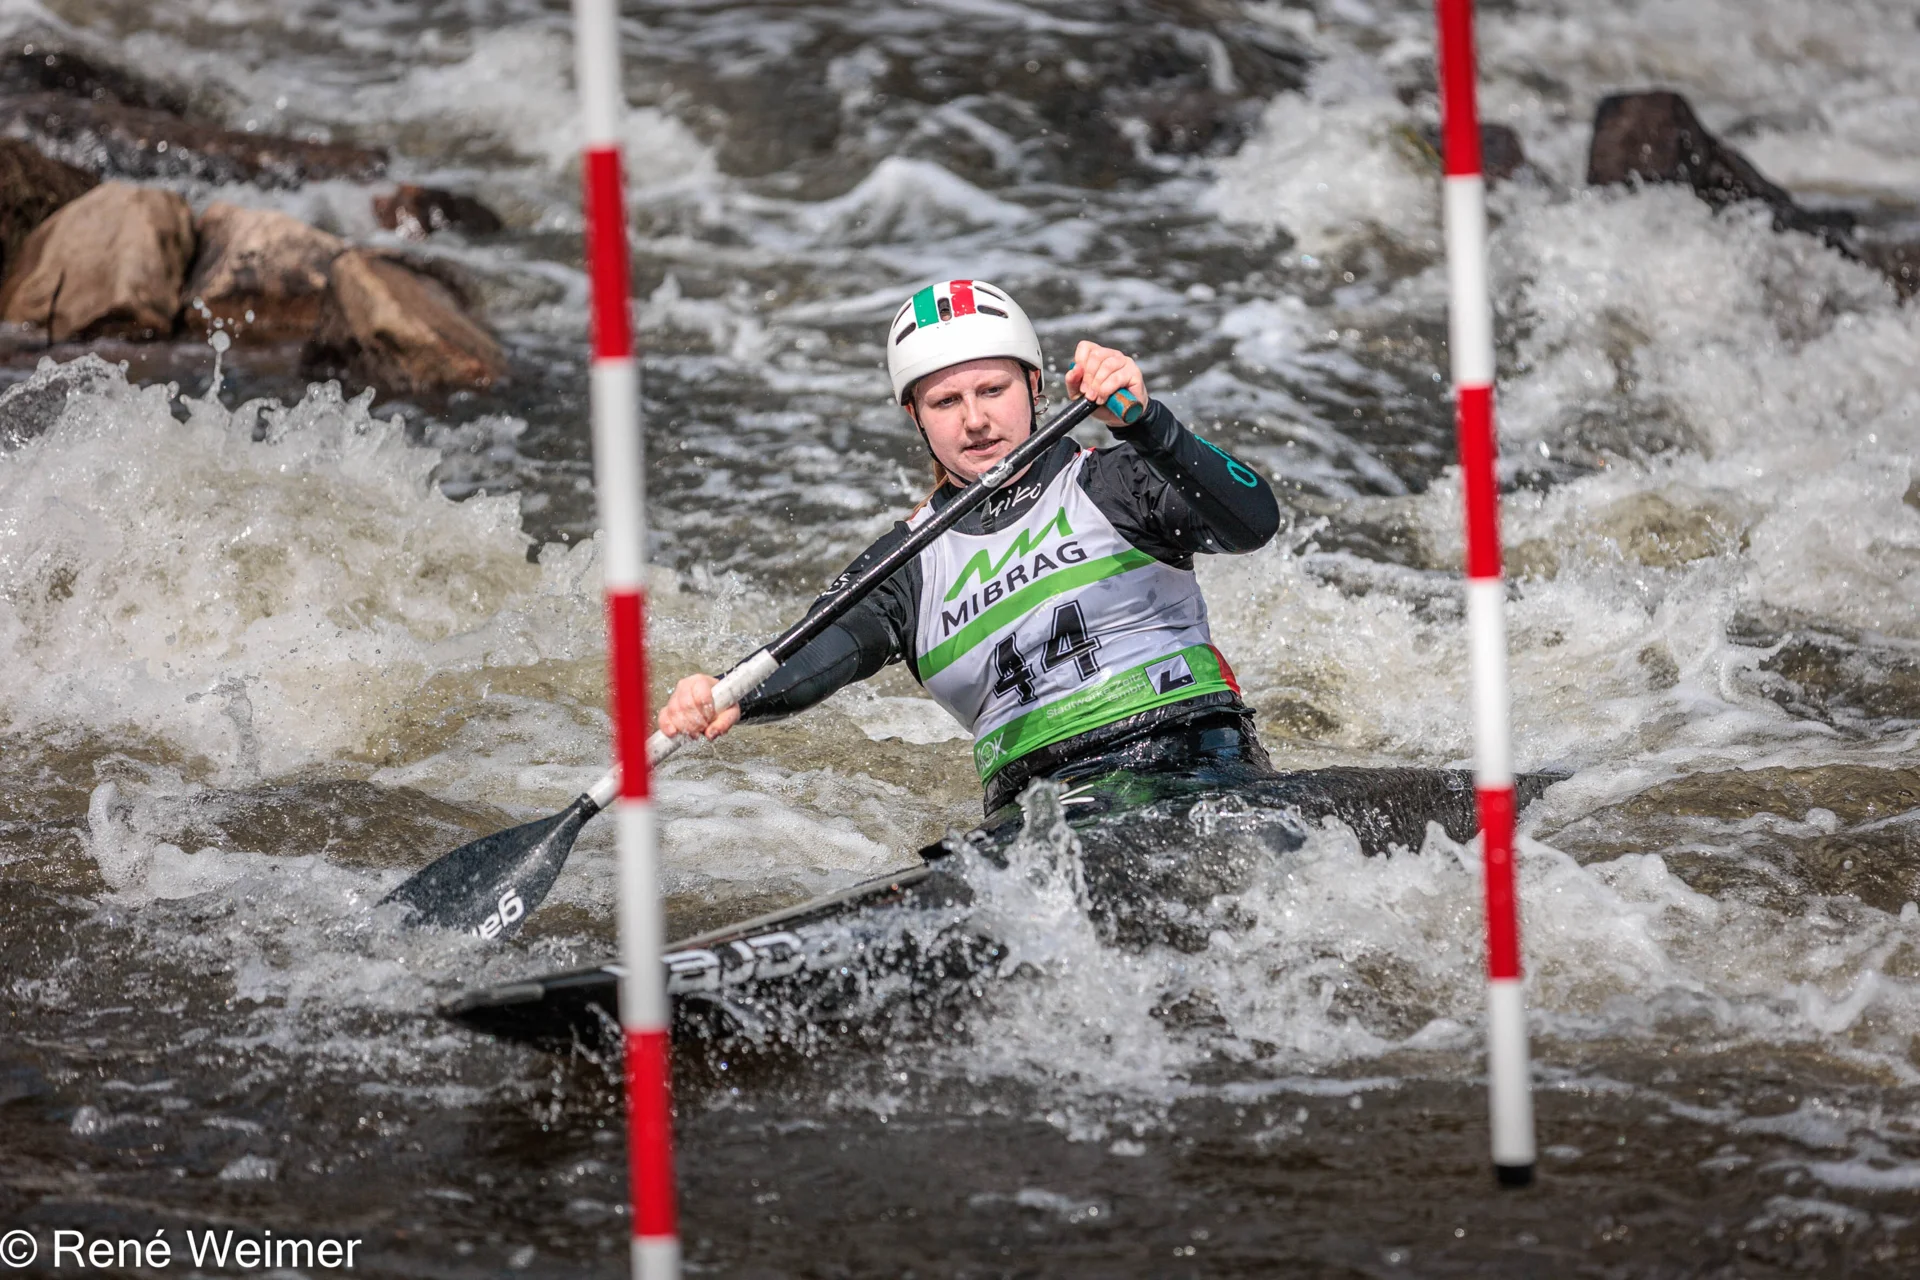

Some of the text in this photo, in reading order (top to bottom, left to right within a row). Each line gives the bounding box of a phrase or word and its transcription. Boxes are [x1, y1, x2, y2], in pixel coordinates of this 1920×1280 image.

[941, 541, 1090, 637] MIBRAG
[992, 600, 1102, 706] 44
[1046, 673, 1143, 719] Stadtwerke Zeitz
